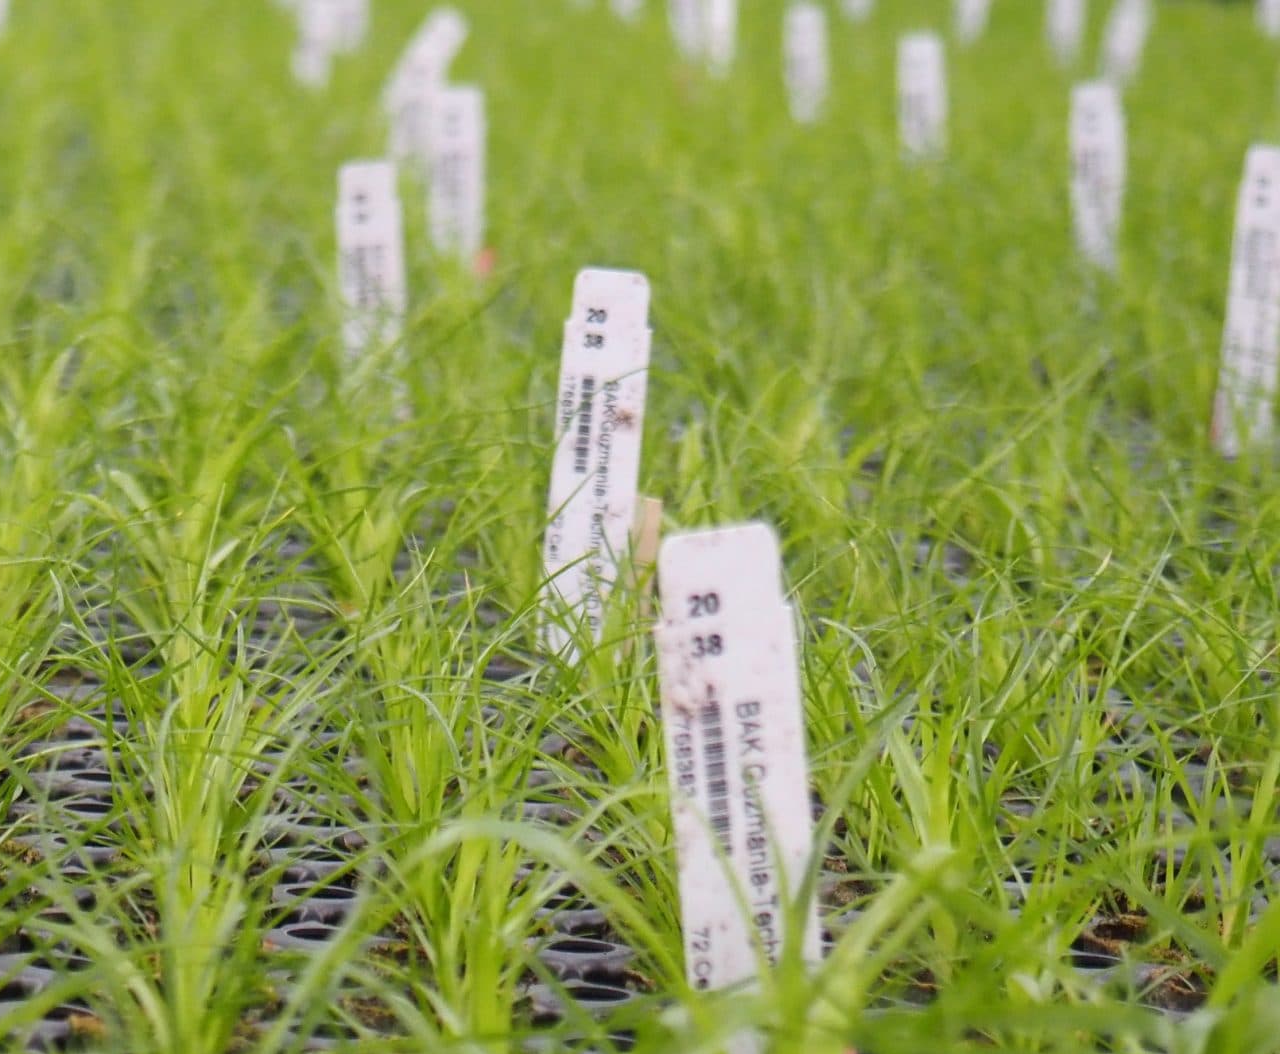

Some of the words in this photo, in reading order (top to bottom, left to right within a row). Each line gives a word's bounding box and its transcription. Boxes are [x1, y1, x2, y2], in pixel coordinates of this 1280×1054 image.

[585, 307, 608, 324] 20
[583, 333, 606, 350] 38
[688, 591, 721, 618] 20
[691, 633, 724, 659] 38
[734, 700, 764, 756] BAK
[691, 927, 710, 952] 72
